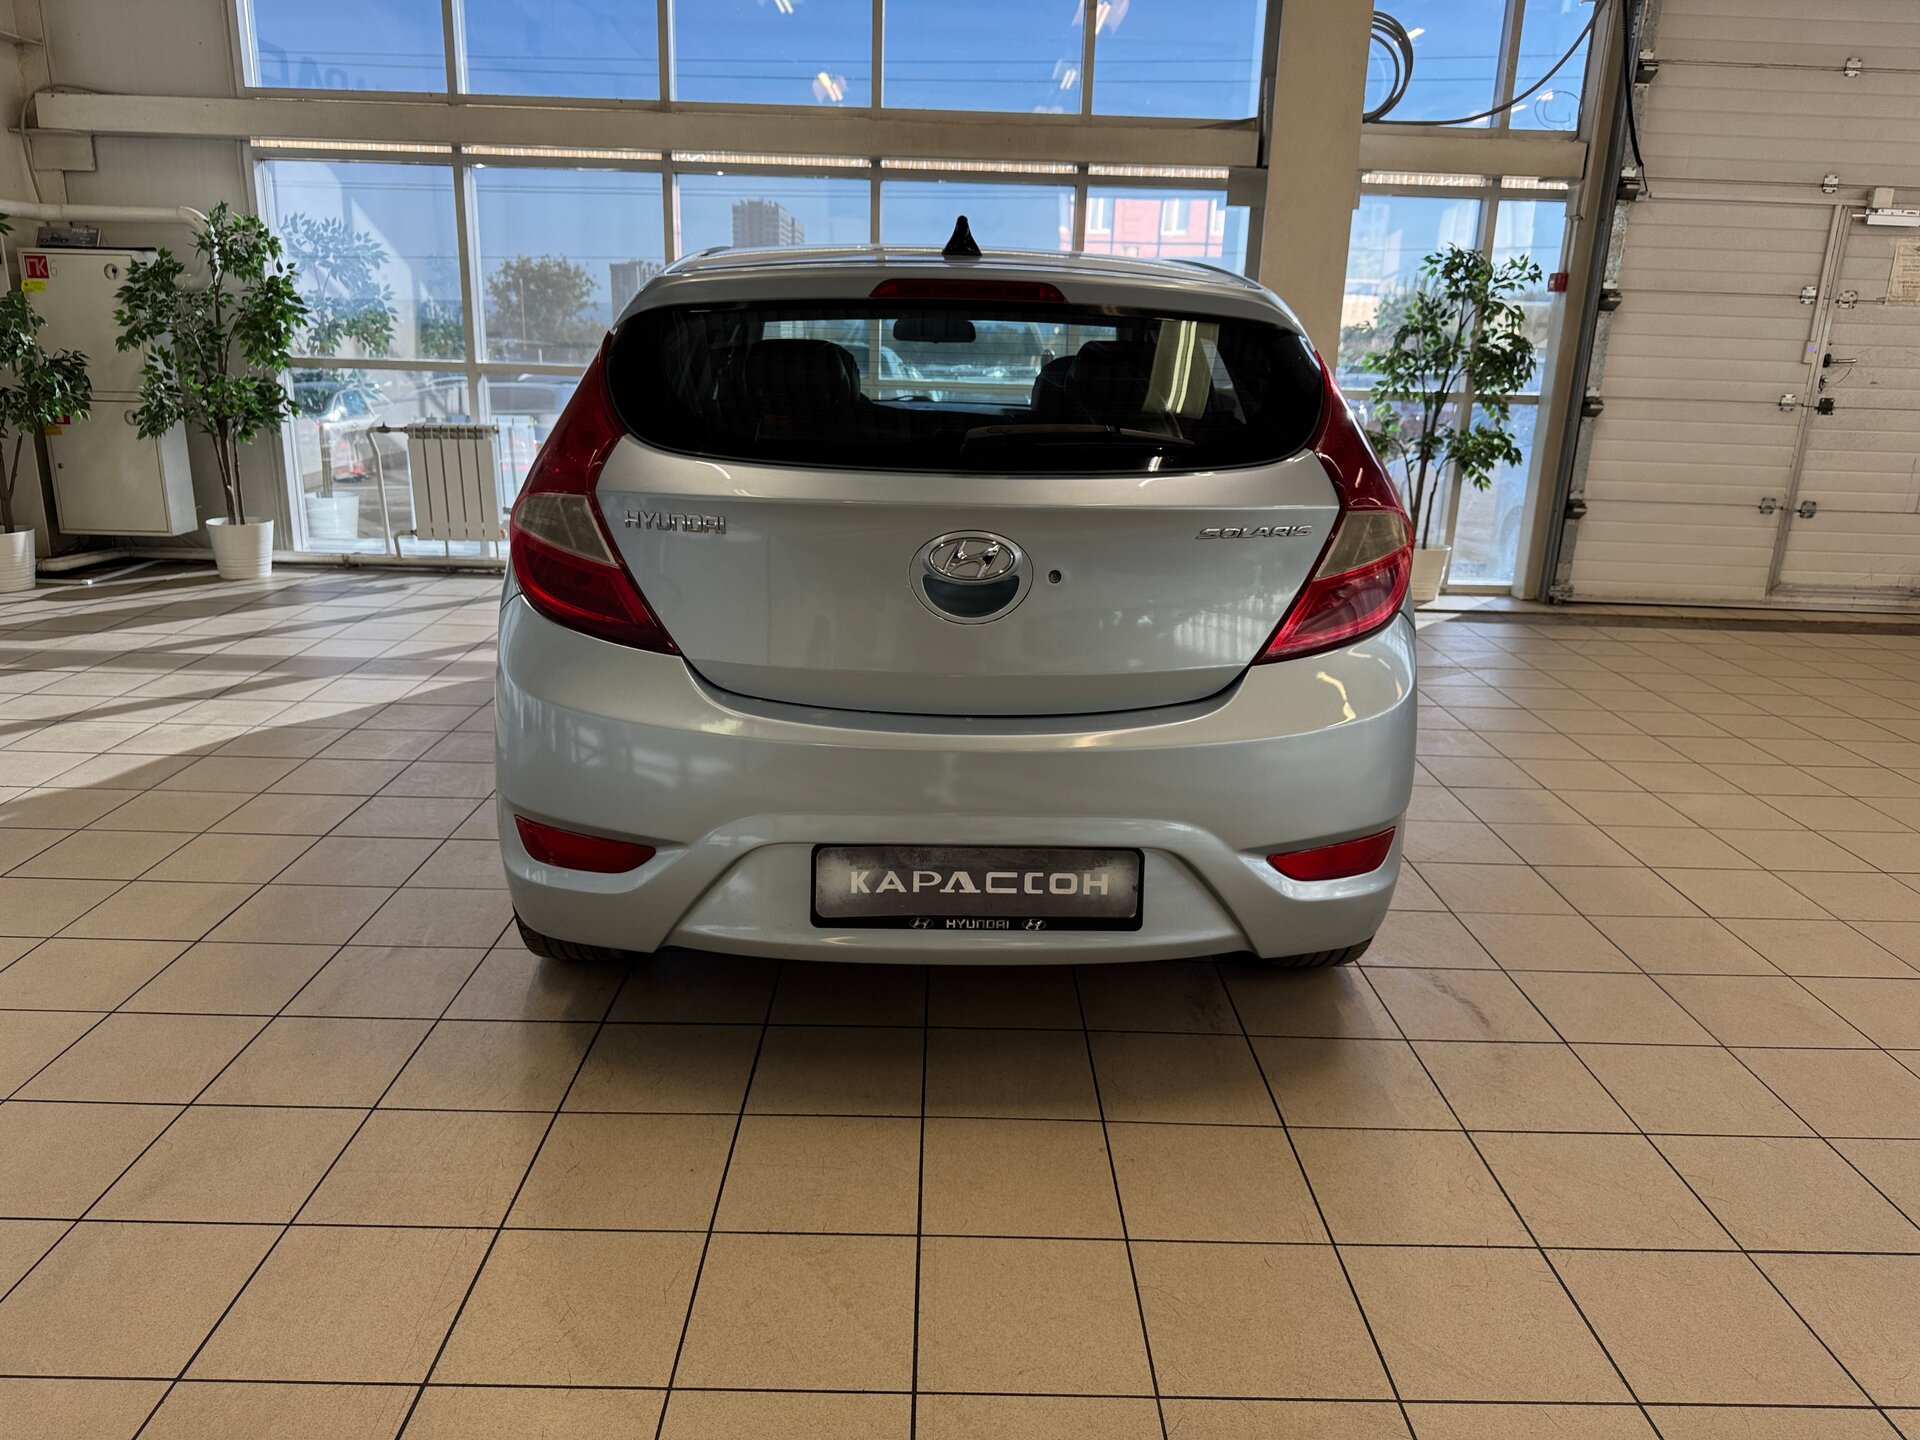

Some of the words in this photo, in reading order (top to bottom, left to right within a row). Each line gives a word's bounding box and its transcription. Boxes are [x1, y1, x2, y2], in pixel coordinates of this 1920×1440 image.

[25, 257, 48, 276] ПК
[49, 258, 58, 277] 6
[625, 510, 726, 535] HYUNDAI
[1196, 524, 1313, 540] SOLARIS
[946, 918, 1010, 929] HYUNDAI
